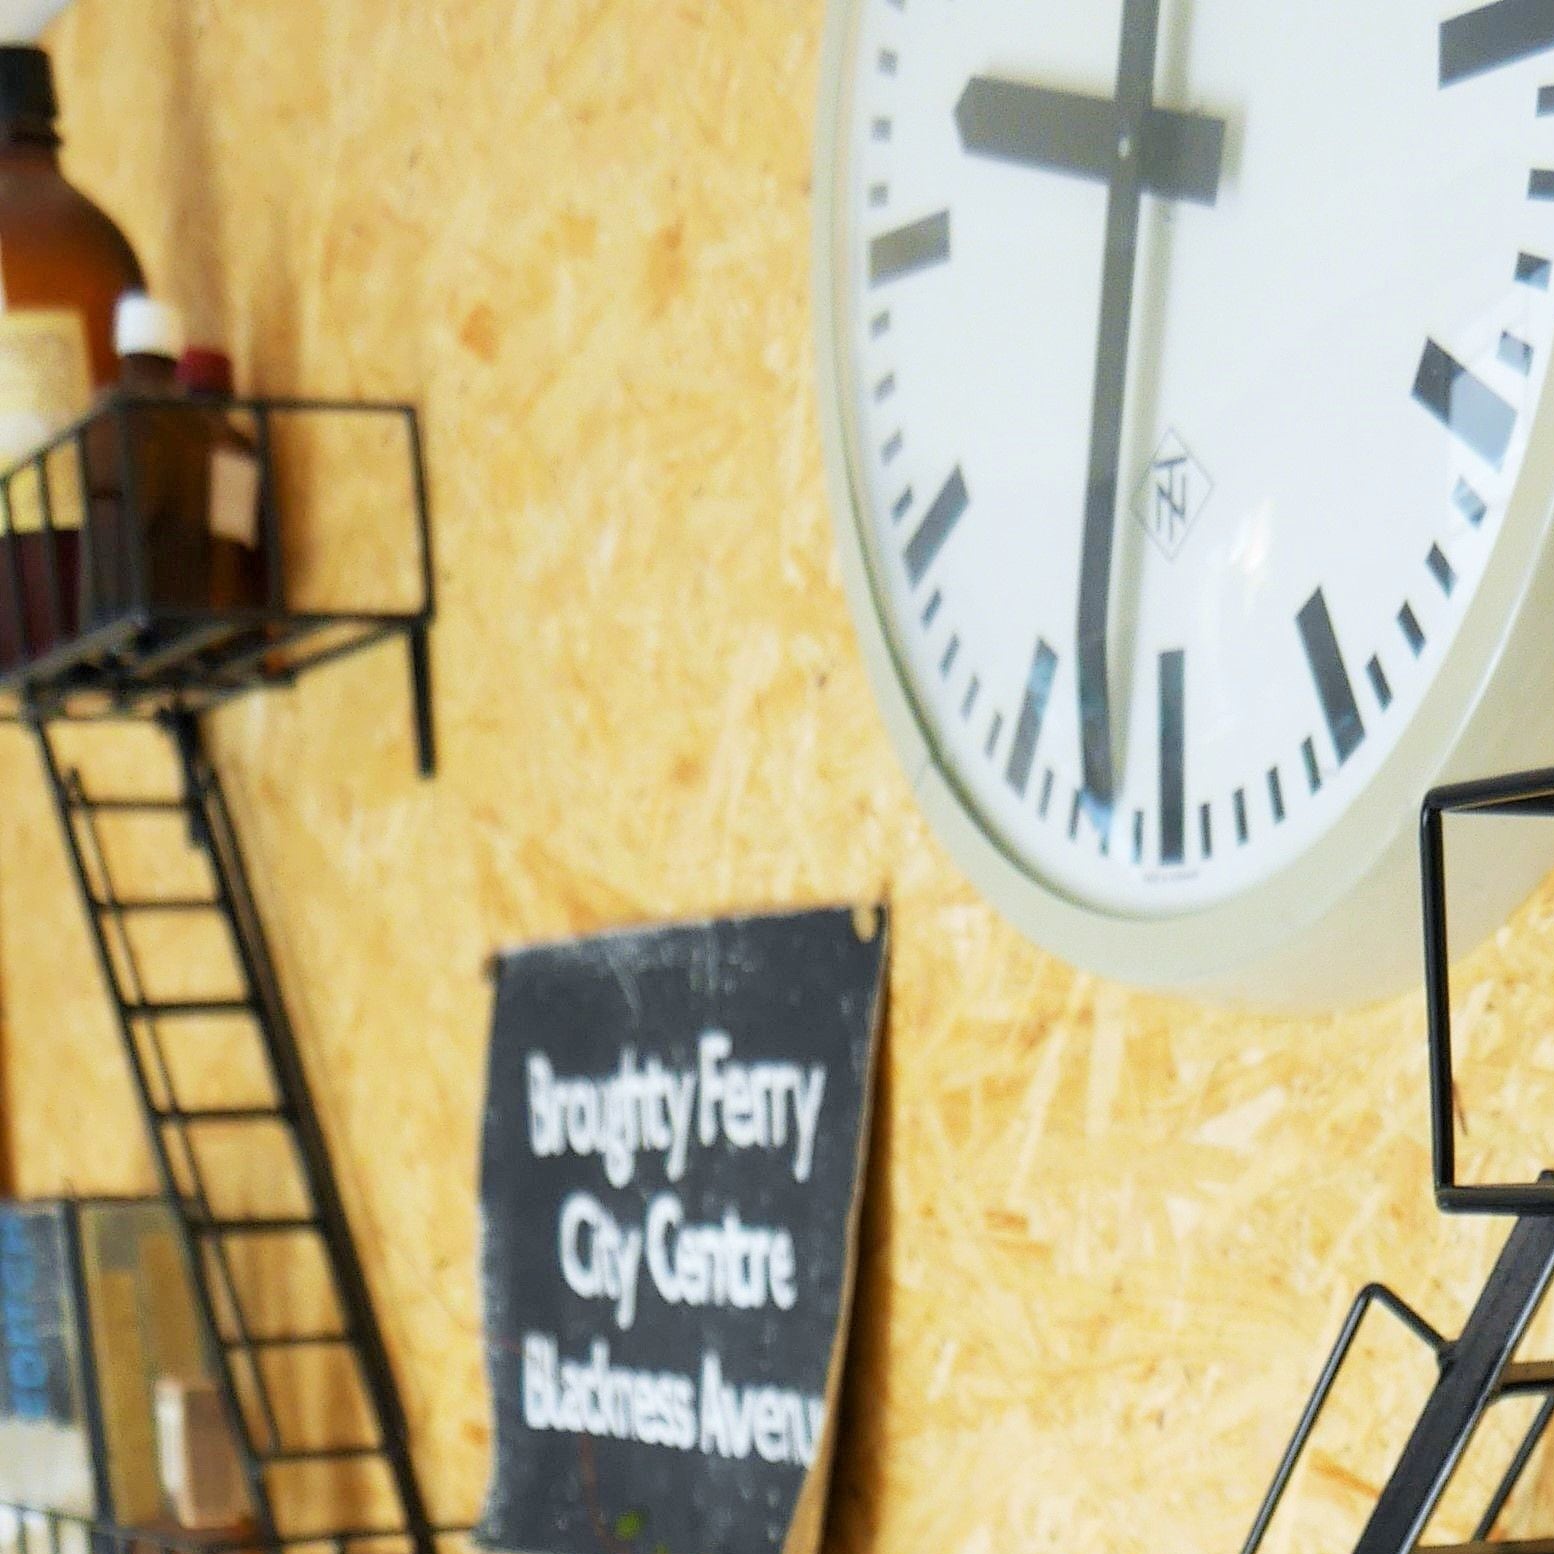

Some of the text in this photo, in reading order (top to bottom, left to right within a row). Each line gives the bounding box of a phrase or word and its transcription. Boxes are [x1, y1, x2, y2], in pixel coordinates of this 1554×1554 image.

[526, 1030, 826, 1188] Broughty Ferry
[559, 1192, 798, 1330] City Centre
[522, 1333, 698, 1450] Blackness
